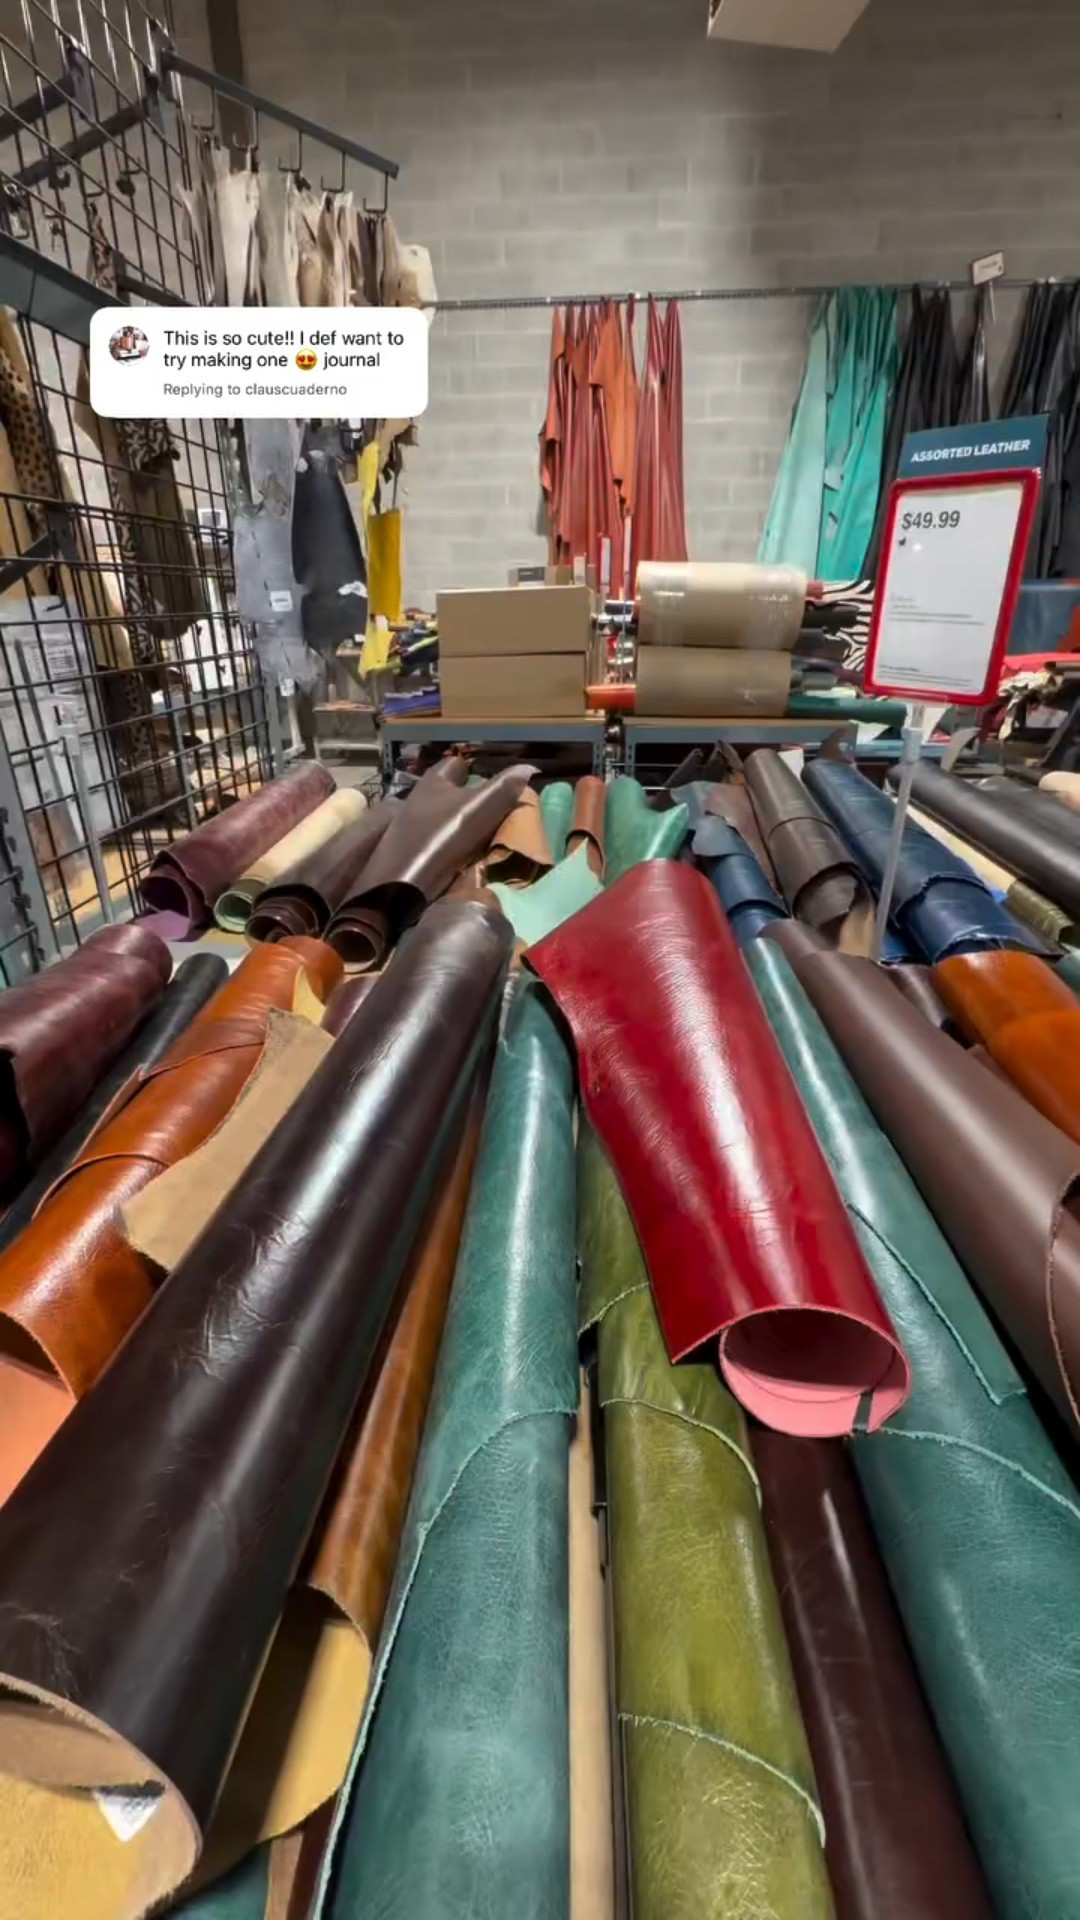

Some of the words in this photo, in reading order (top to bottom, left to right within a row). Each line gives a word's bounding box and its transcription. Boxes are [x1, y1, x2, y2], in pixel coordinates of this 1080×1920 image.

[910, 445, 972, 463] ASSORTED
[973, 438, 1031, 456] LEATHER
[901, 510, 961, 530] $49.99
